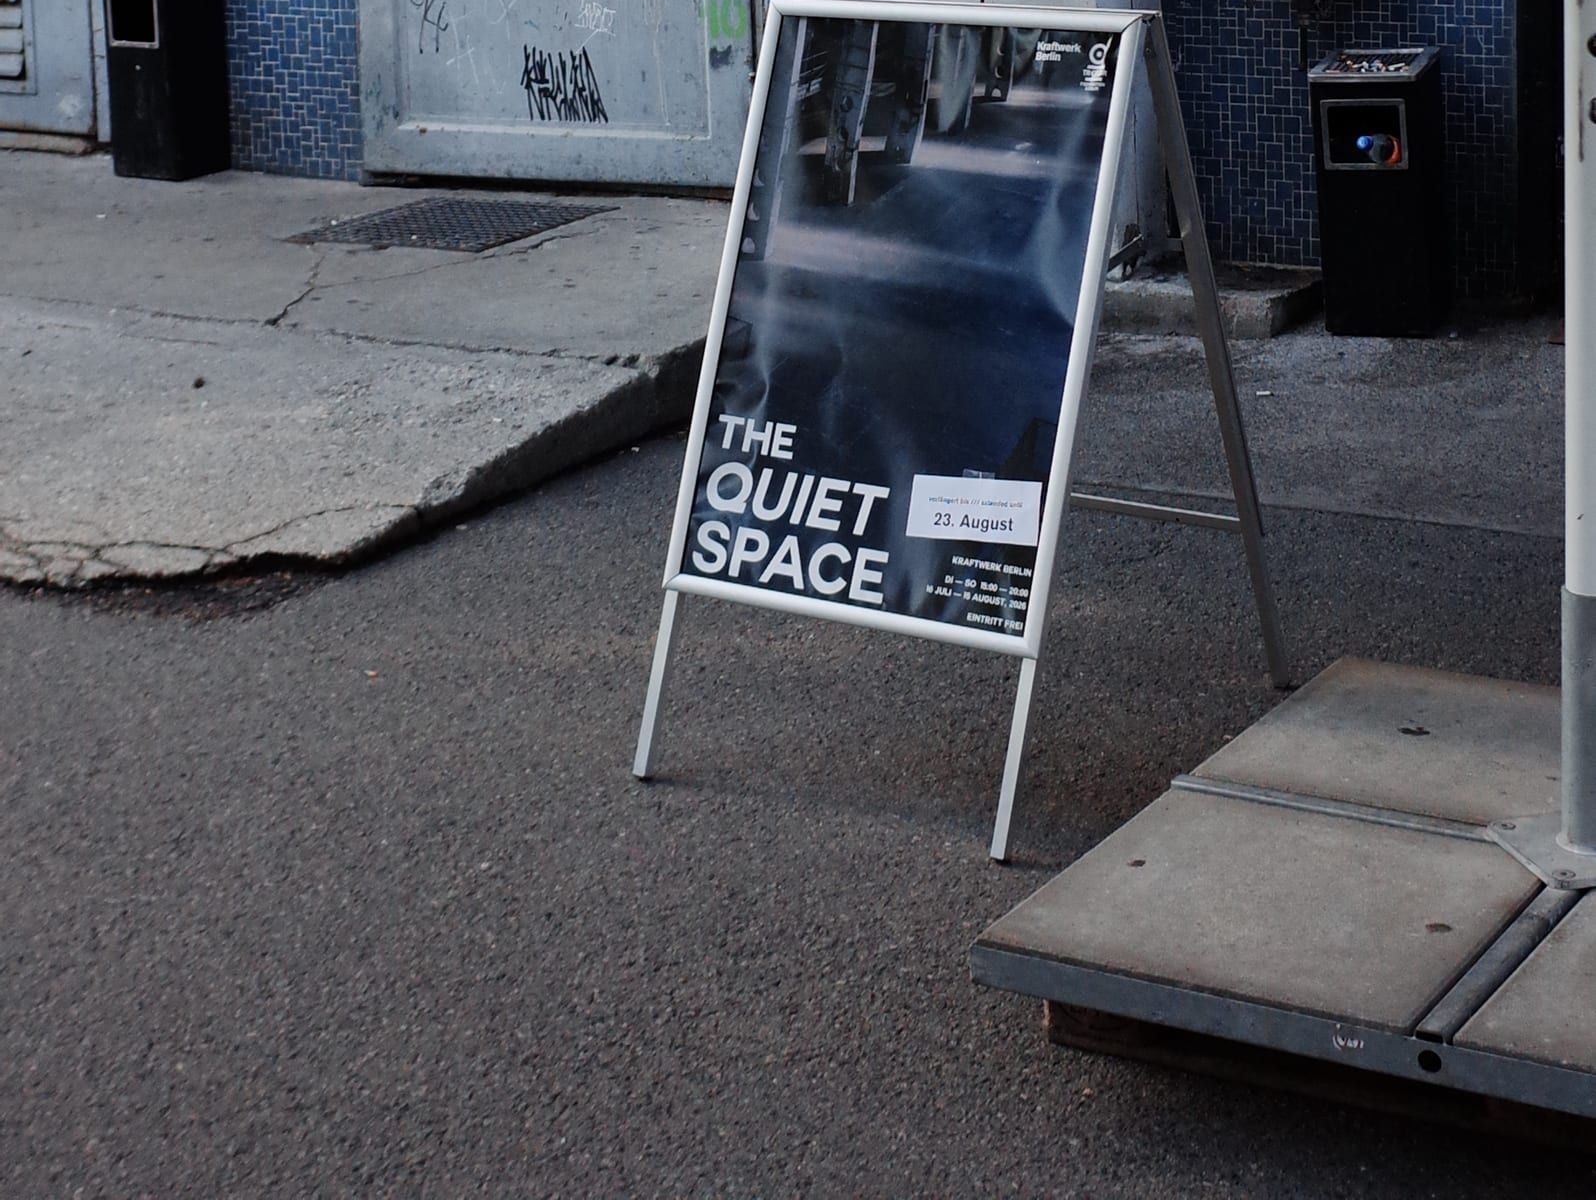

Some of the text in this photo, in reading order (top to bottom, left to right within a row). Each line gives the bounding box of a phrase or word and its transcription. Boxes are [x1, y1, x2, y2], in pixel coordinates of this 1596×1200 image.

[1034, 51, 1062, 62] Berlin
[1036, 41, 1082, 54] Kraftwerk
[718, 413, 797, 460] THE
[706, 461, 891, 536] QUIET
[933, 512, 1014, 533] 23. August
[692, 520, 890, 605] SPACE
[951, 555, 1033, 578] KRAFTWERK BERLIN
[934, 585, 953, 596] JULI
[971, 592, 1008, 608] AUGUST,
[964, 578, 977, 589] SO
[1008, 587, 1029, 598] 20:00
[966, 612, 1024, 631] EINTRITT FREI
